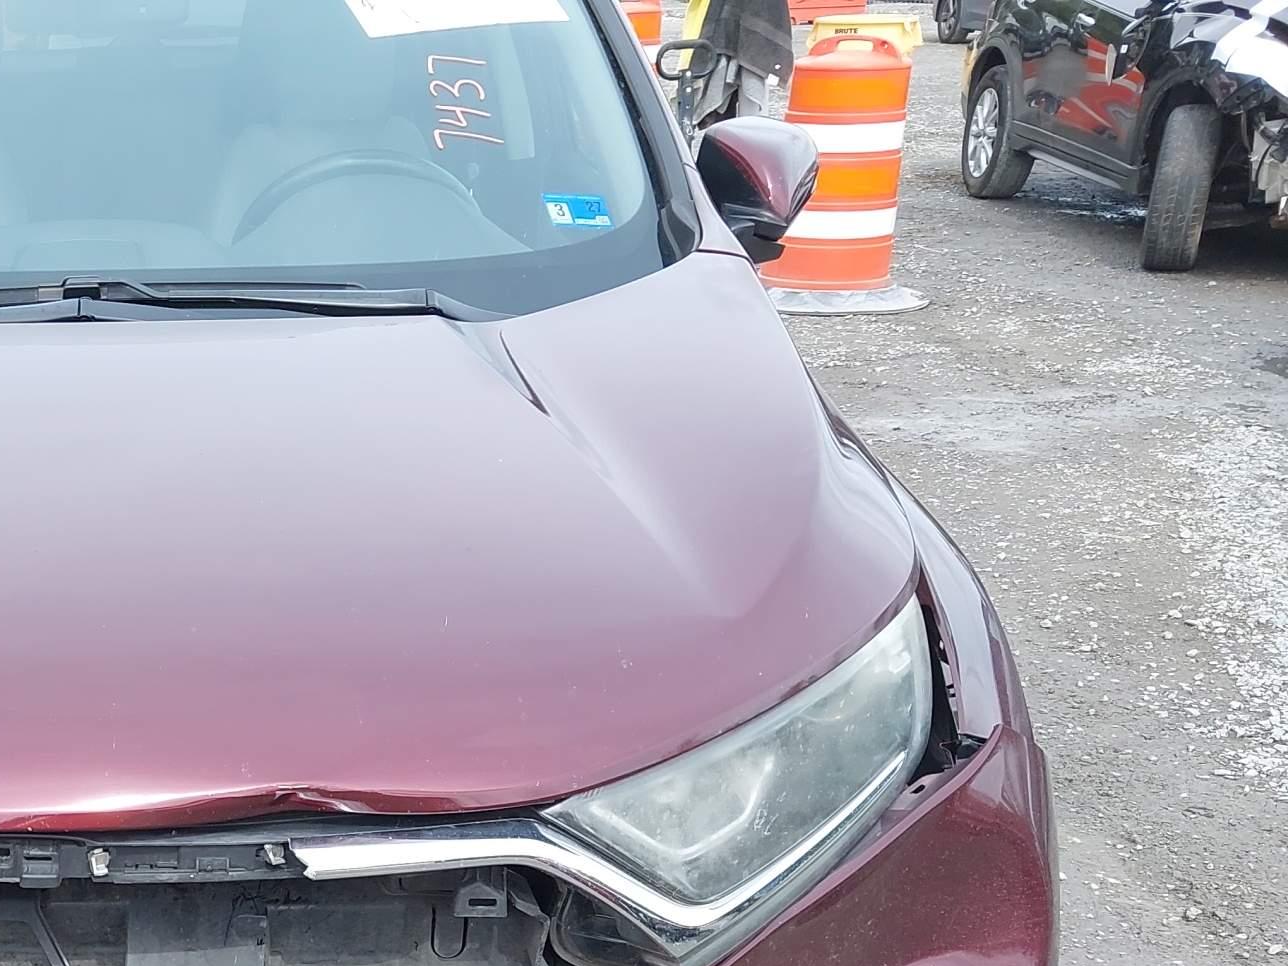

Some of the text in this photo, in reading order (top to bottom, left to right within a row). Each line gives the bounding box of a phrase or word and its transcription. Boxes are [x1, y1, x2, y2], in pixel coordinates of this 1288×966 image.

[834, 27, 859, 35] BRUTE
[427, 54, 505, 150] 7437
[554, 203, 566, 217] 3
[585, 201, 601, 213] 27
